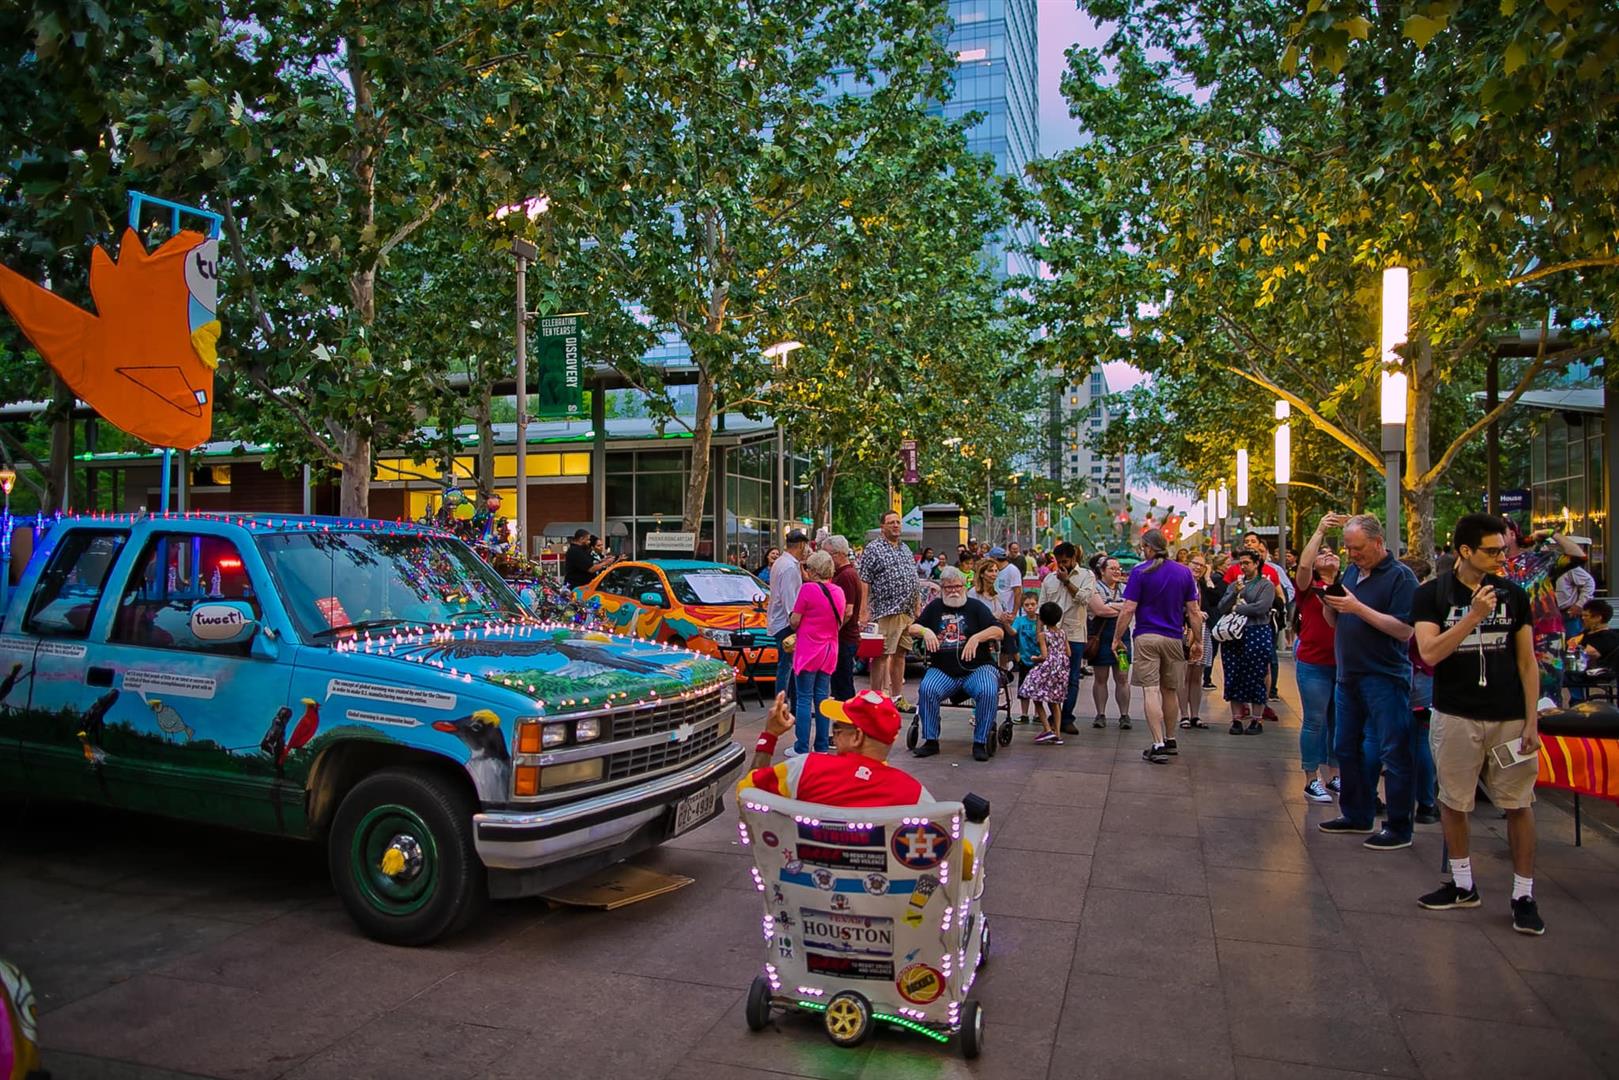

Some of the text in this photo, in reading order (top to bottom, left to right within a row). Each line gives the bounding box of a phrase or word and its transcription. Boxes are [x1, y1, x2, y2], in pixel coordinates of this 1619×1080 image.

[542, 317, 577, 328] CELEBRATING
[542, 327, 552, 337] TEN
[553, 326, 570, 336] YEARS
[565, 337, 578, 388] DISCOVERY
[195, 611, 242, 625] tweet!
[803, 920, 892, 944] HOUSTON
[779, 947, 793, 958] TX
